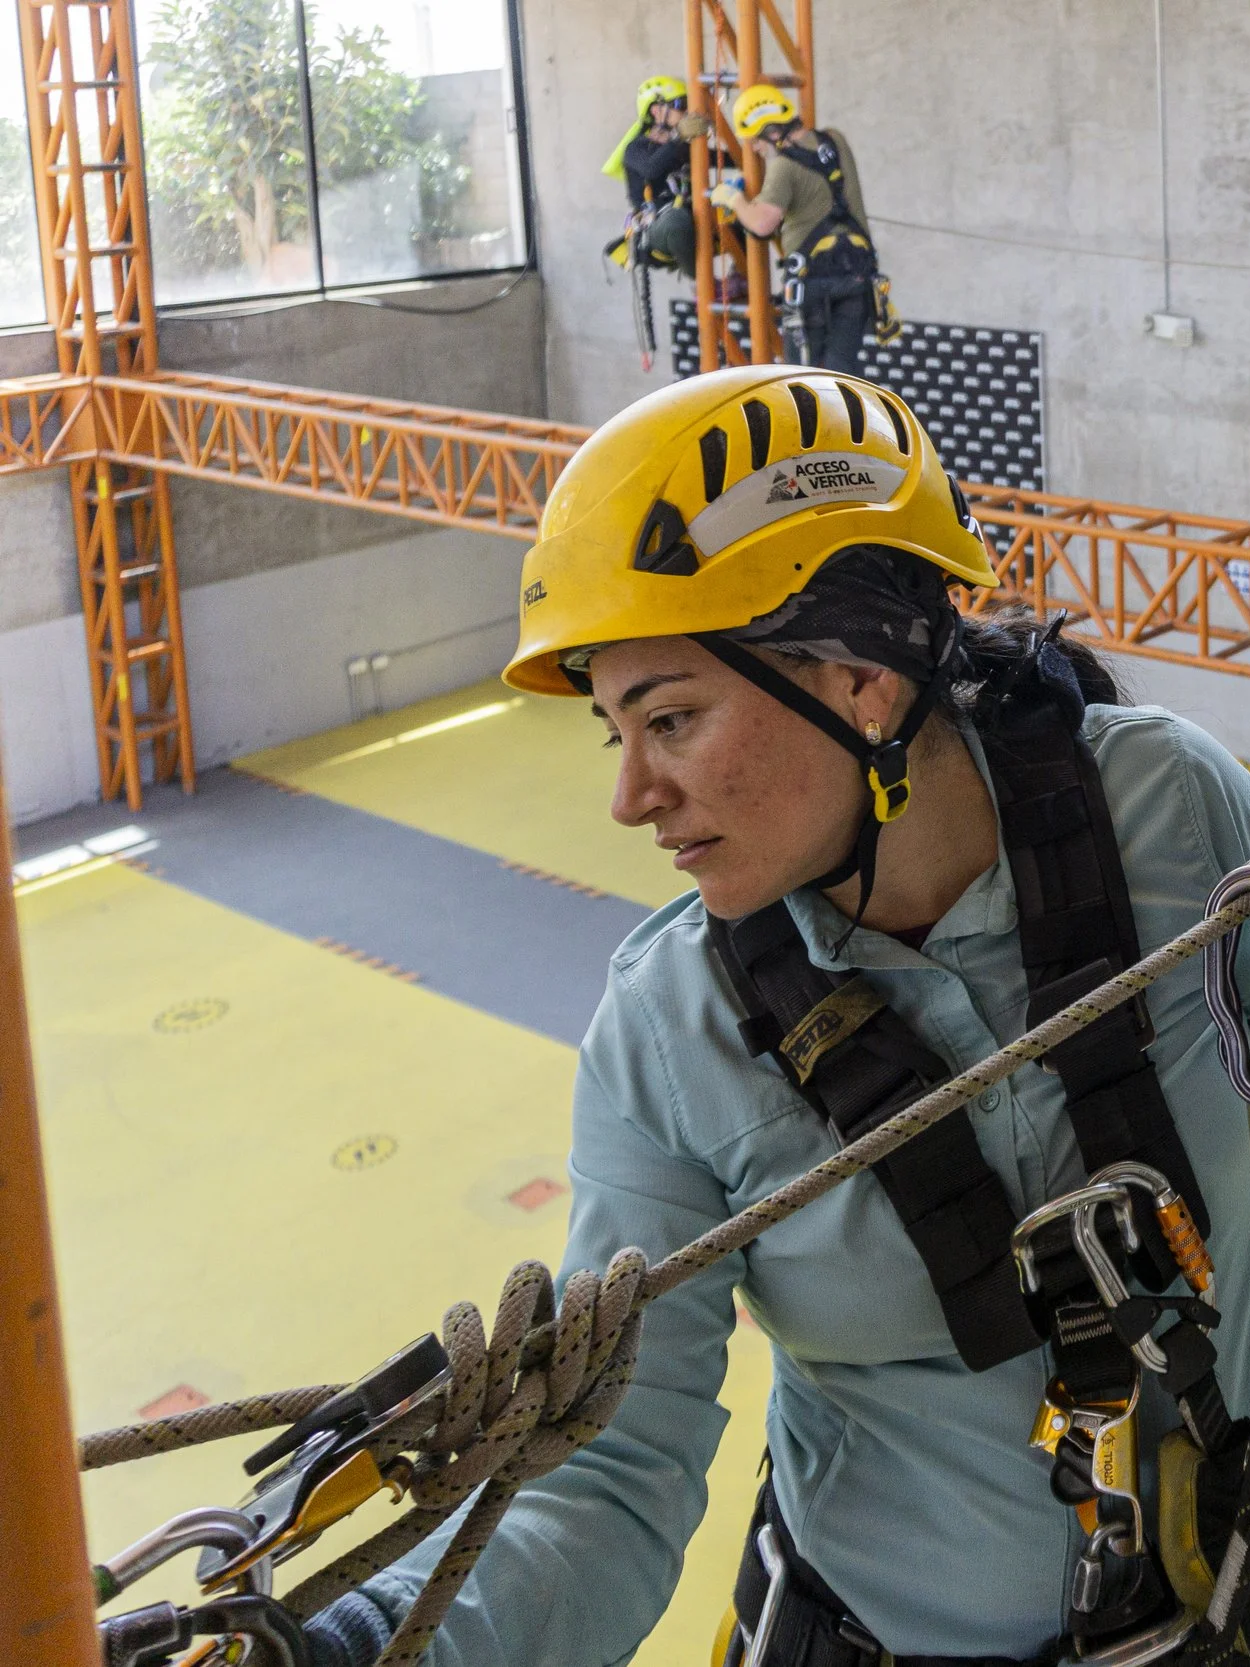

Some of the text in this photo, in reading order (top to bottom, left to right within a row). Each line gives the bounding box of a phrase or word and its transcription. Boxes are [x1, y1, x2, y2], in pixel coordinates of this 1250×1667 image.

[796, 460, 850, 477] ACCESO
[809, 472, 875, 489] VERTICAL
[1103, 1451, 1114, 1486] CROLL
